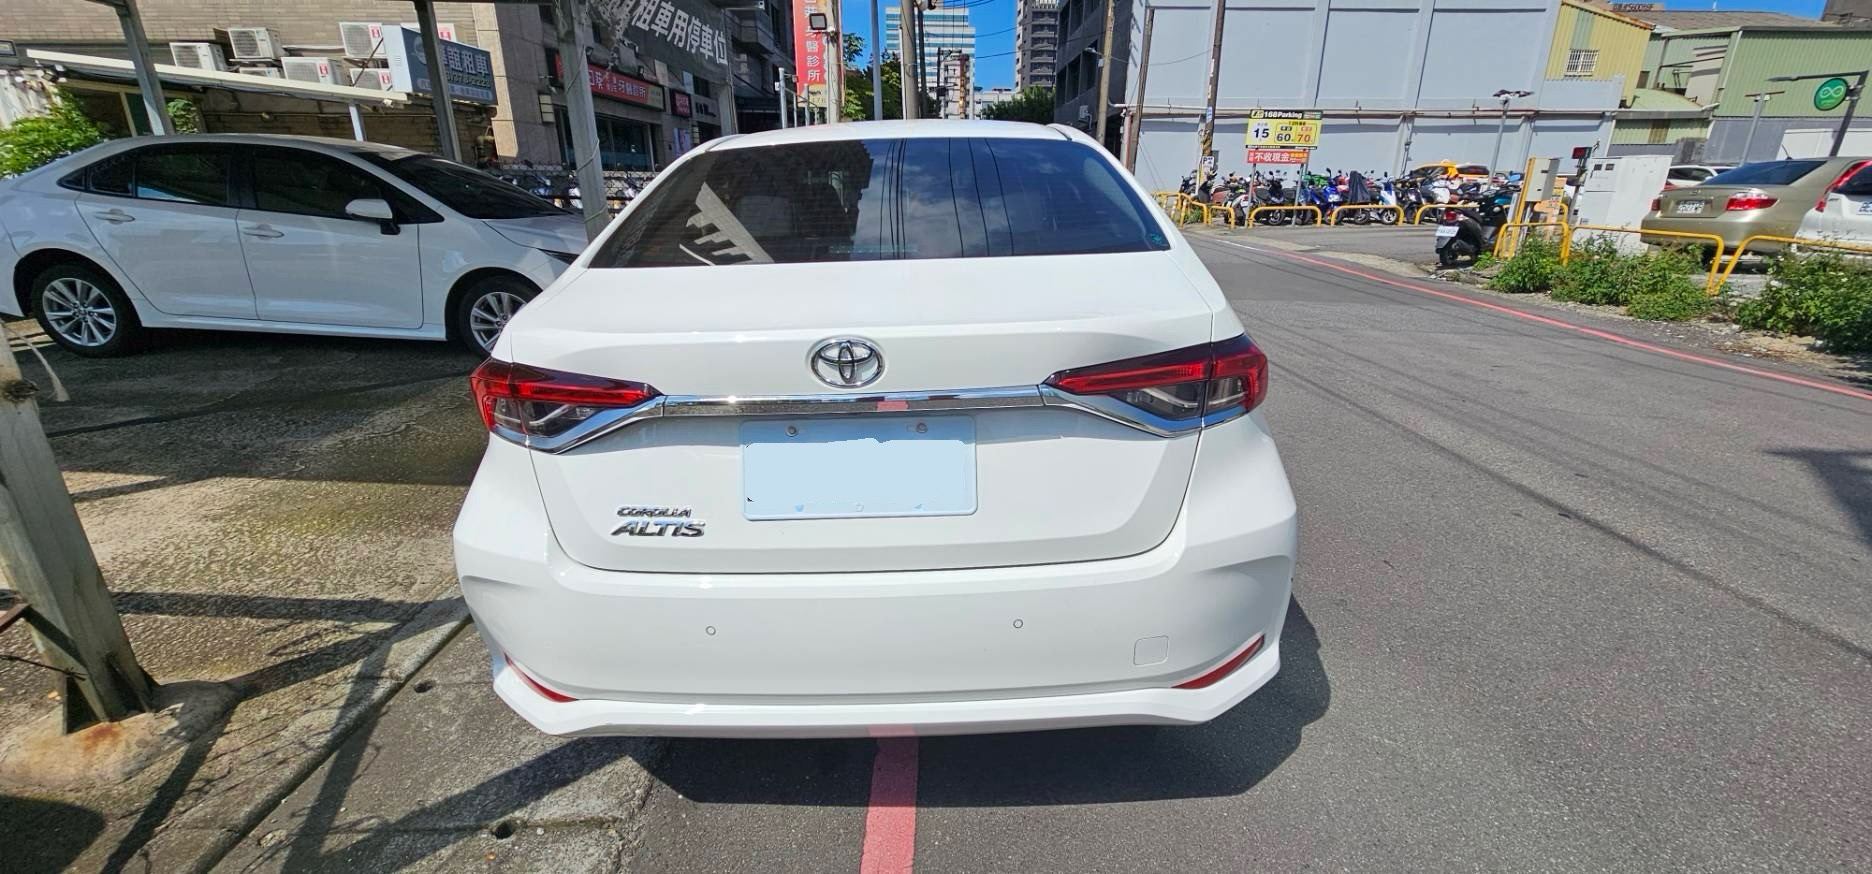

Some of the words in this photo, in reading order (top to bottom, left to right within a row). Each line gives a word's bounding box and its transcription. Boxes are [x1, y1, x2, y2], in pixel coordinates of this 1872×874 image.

[804, 0, 820, 81] 醫診所
[1254, 128, 1270, 138] 15
[1276, 133, 1291, 142] 60
[1297, 134, 1311, 142] 70
[1255, 152, 1290, 162] 不收現金
[617, 506, 692, 518] COROLLA
[611, 520, 706, 538] ALTIS
